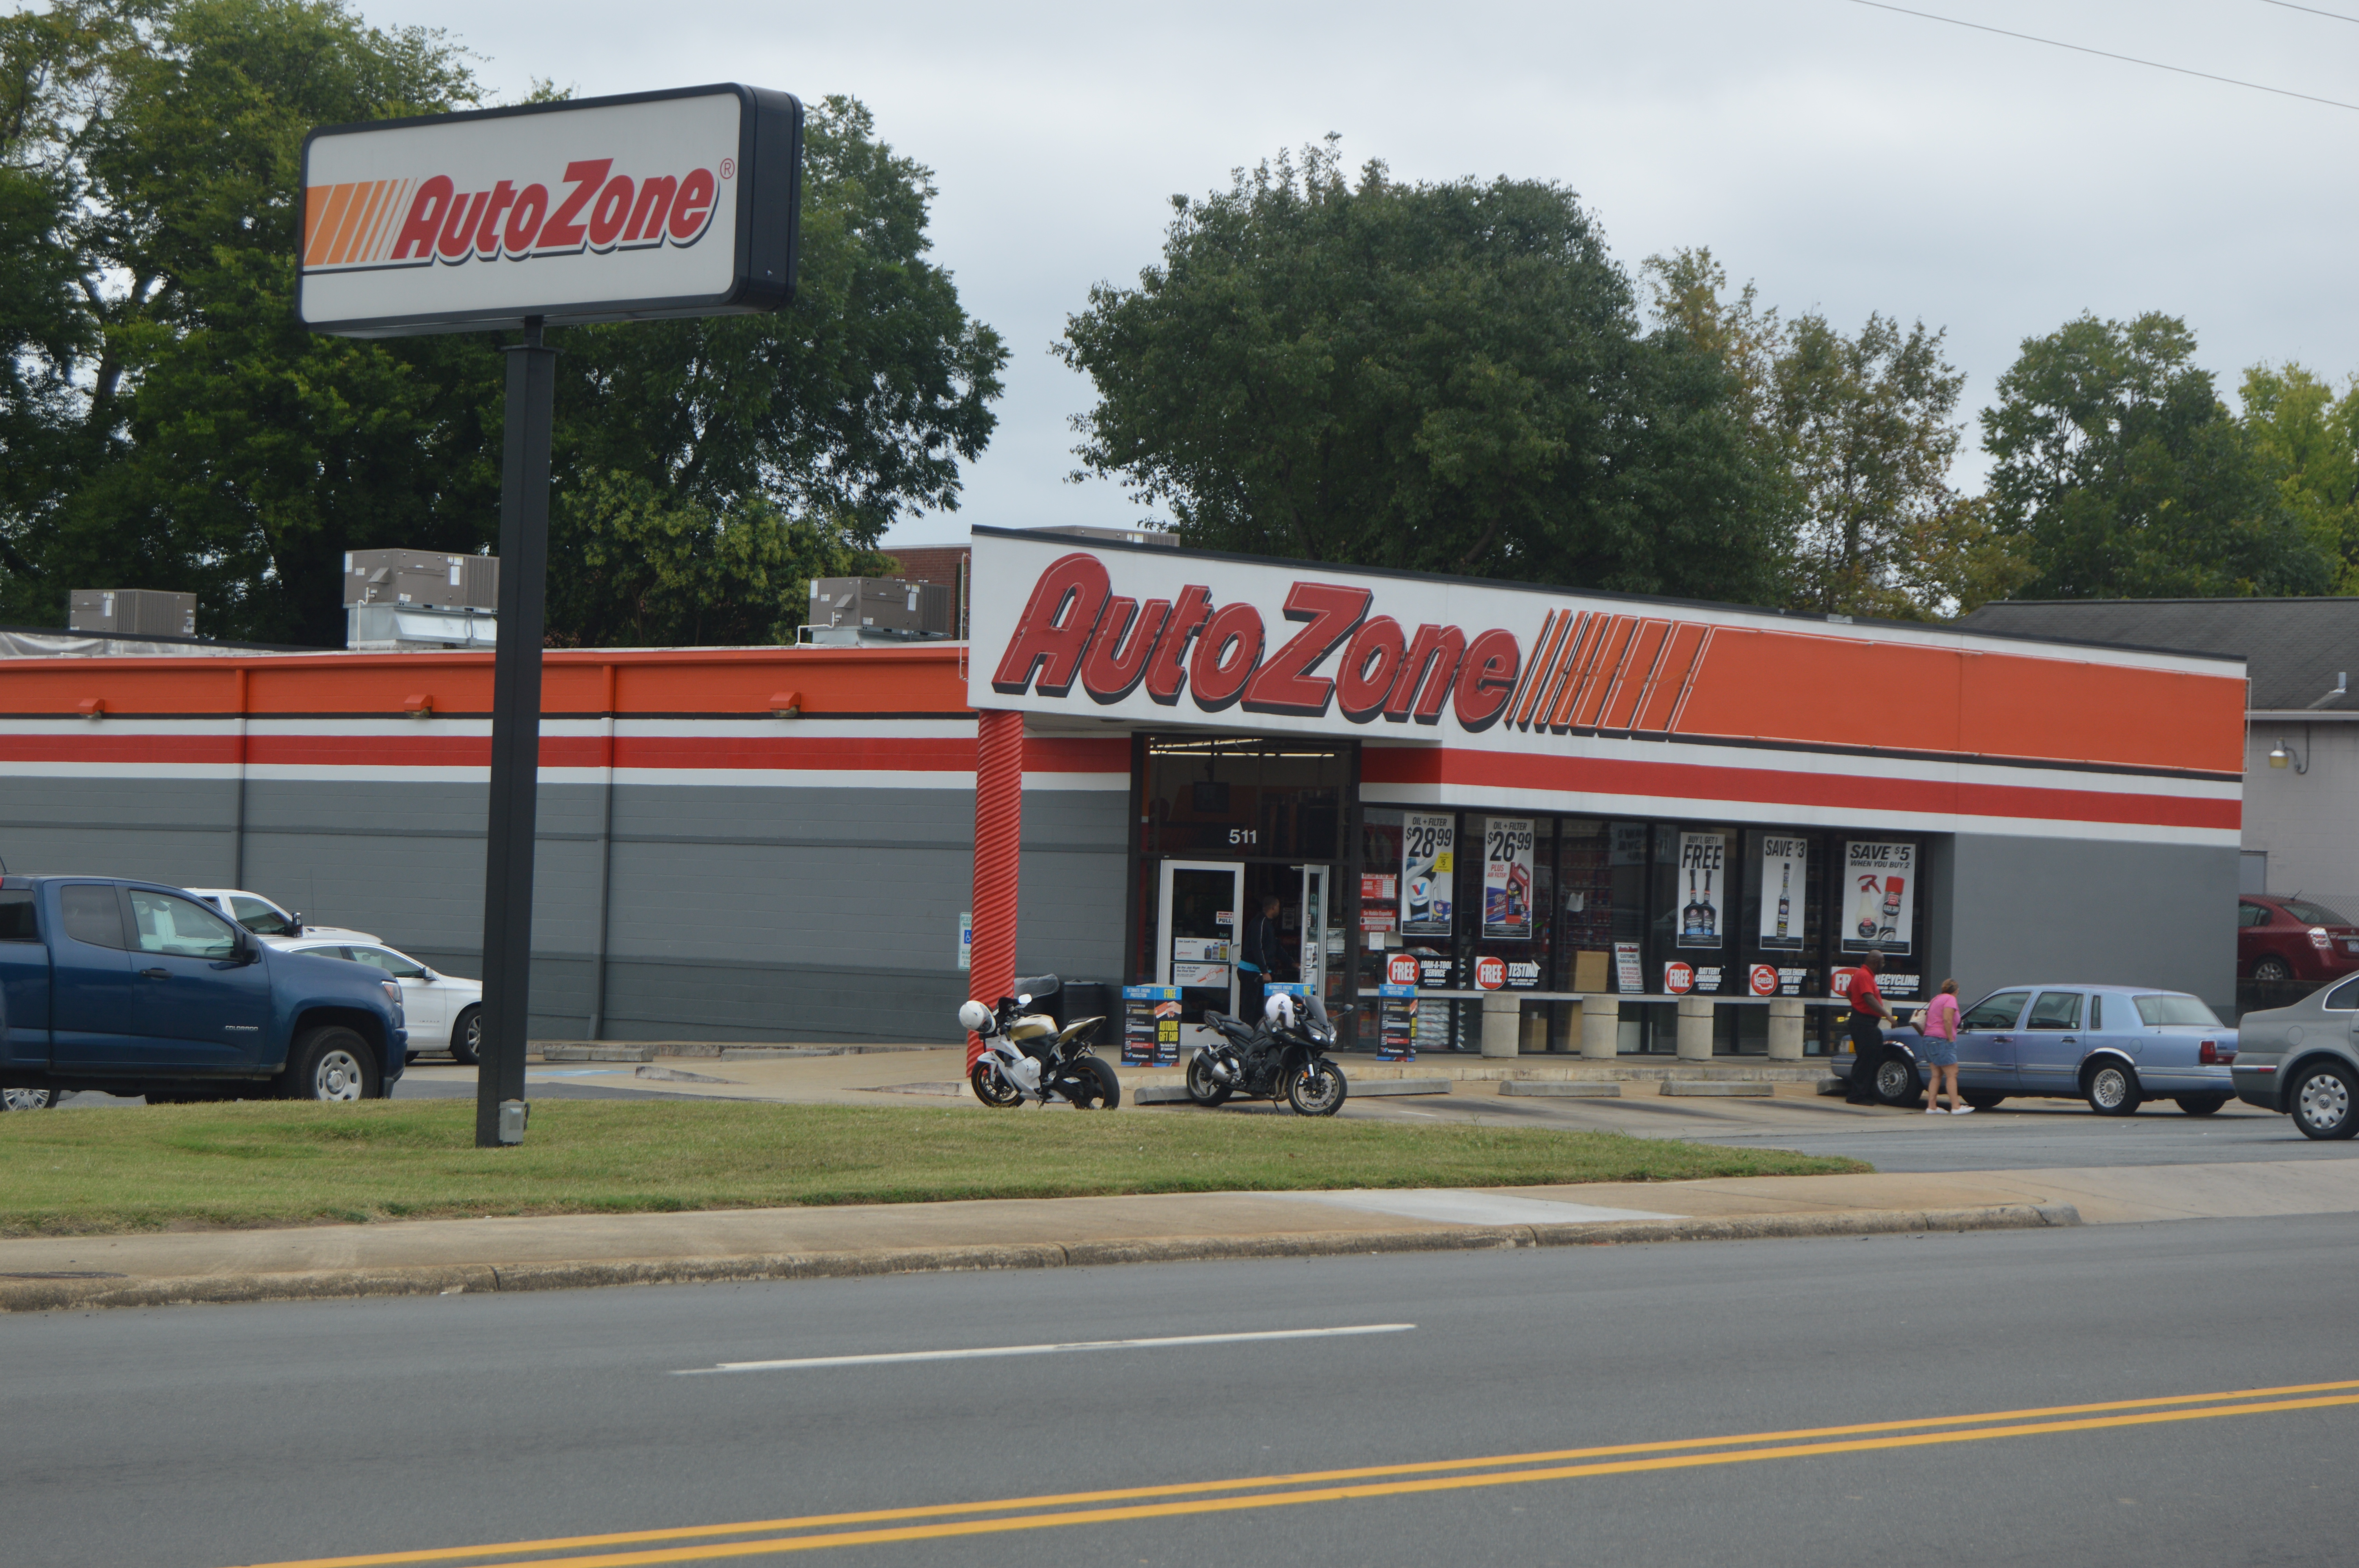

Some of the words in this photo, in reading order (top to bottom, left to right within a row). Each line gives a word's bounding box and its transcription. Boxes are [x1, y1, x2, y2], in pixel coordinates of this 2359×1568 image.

[390, 158, 719, 265] AutoZone
[991, 552, 1521, 732] AutoZone
[1412, 817, 1421, 825] OIL
[1428, 818, 1447, 826] FILTER
[1493, 822, 1502, 830] OIL
[1229, 829, 1256, 844] 511
[1682, 844, 1723, 869] FREE
[1765, 839, 1793, 857] SAVE
[1796, 842, 1806, 858] $3
[1850, 844, 1892, 860] SAVE
[1894, 846, 1911, 860] $5
[1392, 962, 1415, 981] FREE
[1421, 960, 1452, 969] LOAN-A-TOOL
[1425, 969, 1446, 977] SERVICE
[1481, 964, 1503, 983] FREE
[1669, 969, 1690, 987] FREE
[1695, 975, 1722, 983] CHARGING
[1835, 973, 1854, 991] FR
[1875, 974, 1920, 986] RECYCLING
[1164, 989, 1176, 998] FREE
[1159, 1021, 1178, 1031] AUTOZONE
[1159, 1031, 1169, 1042] GIFT
[1169, 1031, 1178, 1042] CARD
